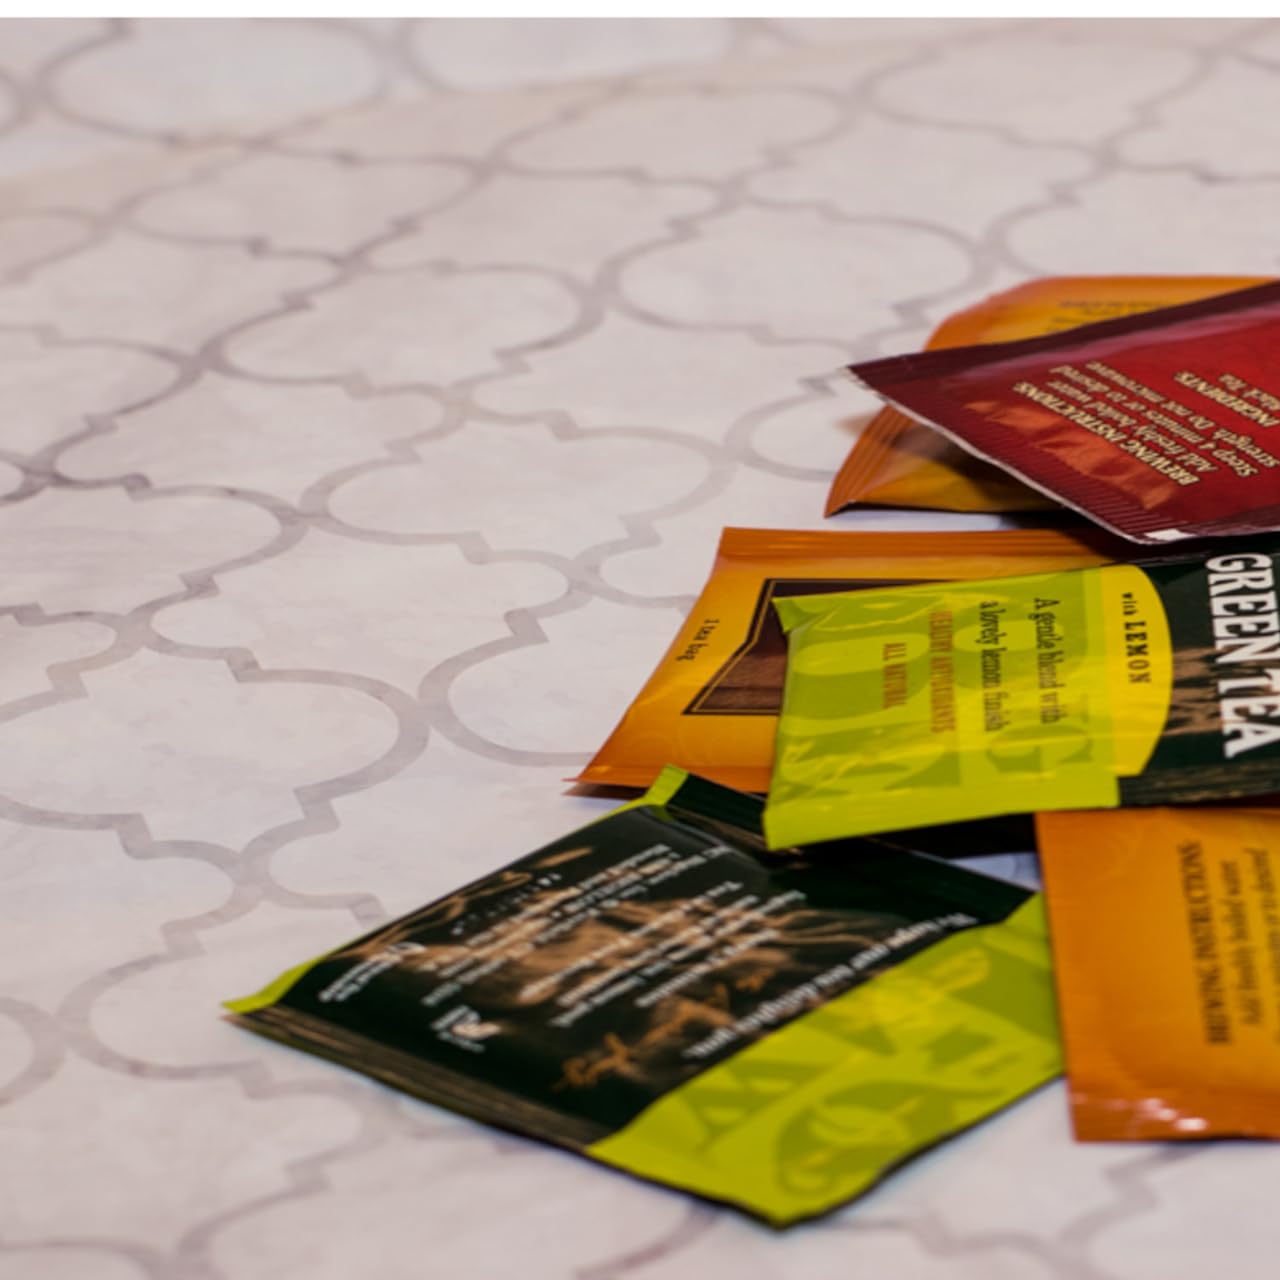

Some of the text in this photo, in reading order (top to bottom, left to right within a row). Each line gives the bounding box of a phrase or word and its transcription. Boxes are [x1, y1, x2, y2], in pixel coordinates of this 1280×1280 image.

[1156, 400, 1193, 415] not
[1181, 415, 1219, 429] Do
[1112, 441, 1204, 483] BREWING
[1124, 424, 1195, 454] freshly
[1138, 410, 1269, 476] Steep minutes
[1171, 453, 1220, 471] Add
[675, 625, 715, 662] tea bag
[1028, 595, 1066, 725] A gentle blend with
[1121, 592, 1149, 685] with LEMON
[881, 641, 907, 709] ALL NATURAL
[927, 610, 957, 734] HEALTHY ANTIOXIDANTS
[975, 600, 1010, 732] a lovely lemon finish
